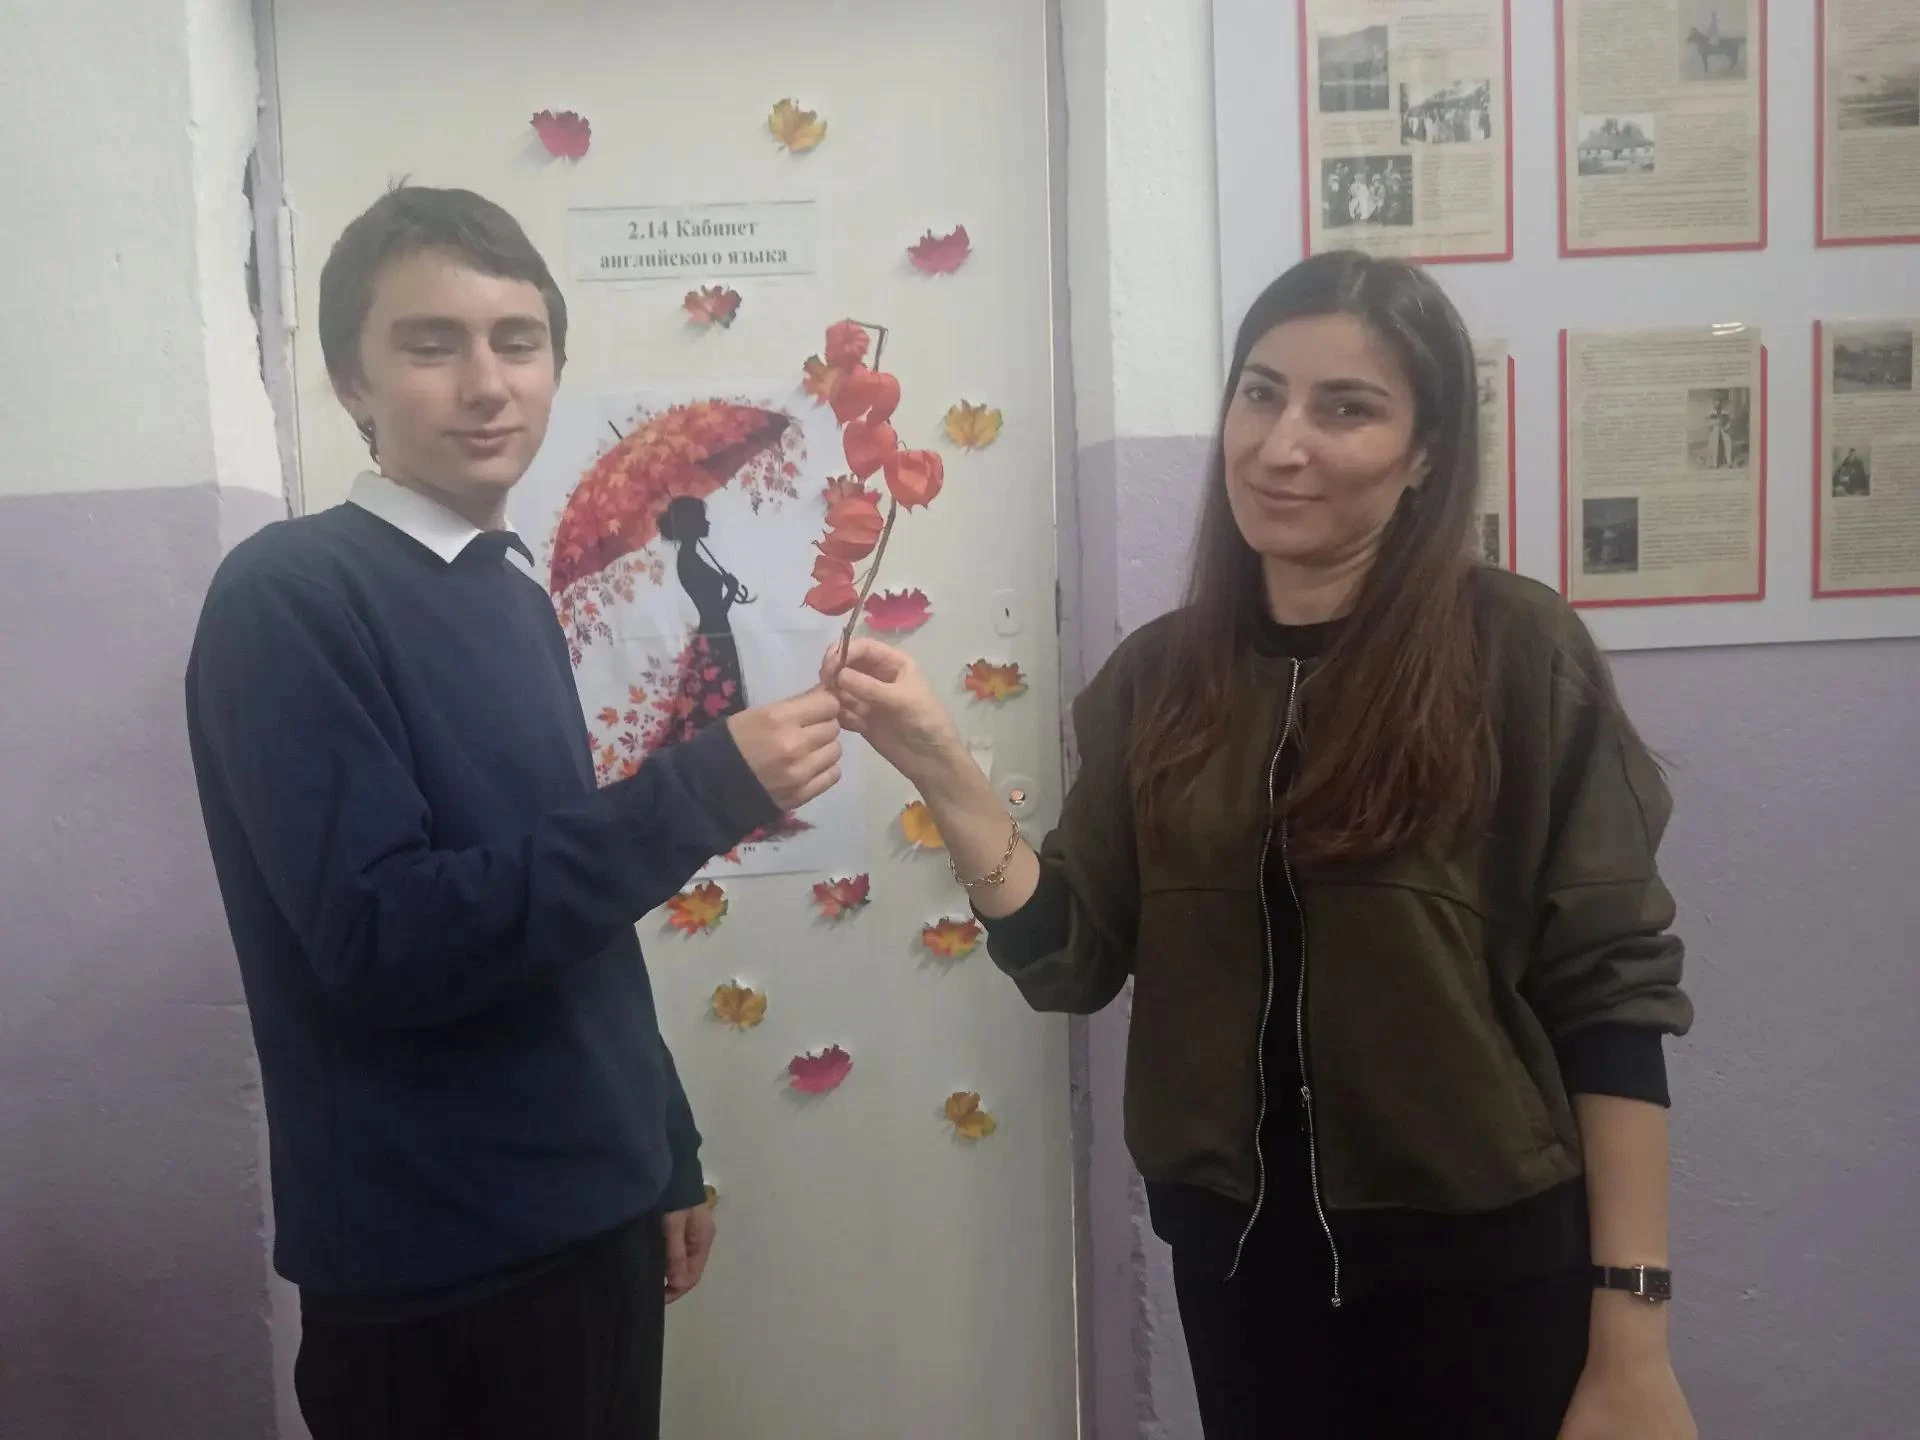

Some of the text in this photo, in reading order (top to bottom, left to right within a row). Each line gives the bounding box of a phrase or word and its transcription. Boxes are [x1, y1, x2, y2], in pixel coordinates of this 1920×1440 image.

[628, 218, 757, 240] 2.14 Кабинет
[600, 249, 788, 270] английского языка
